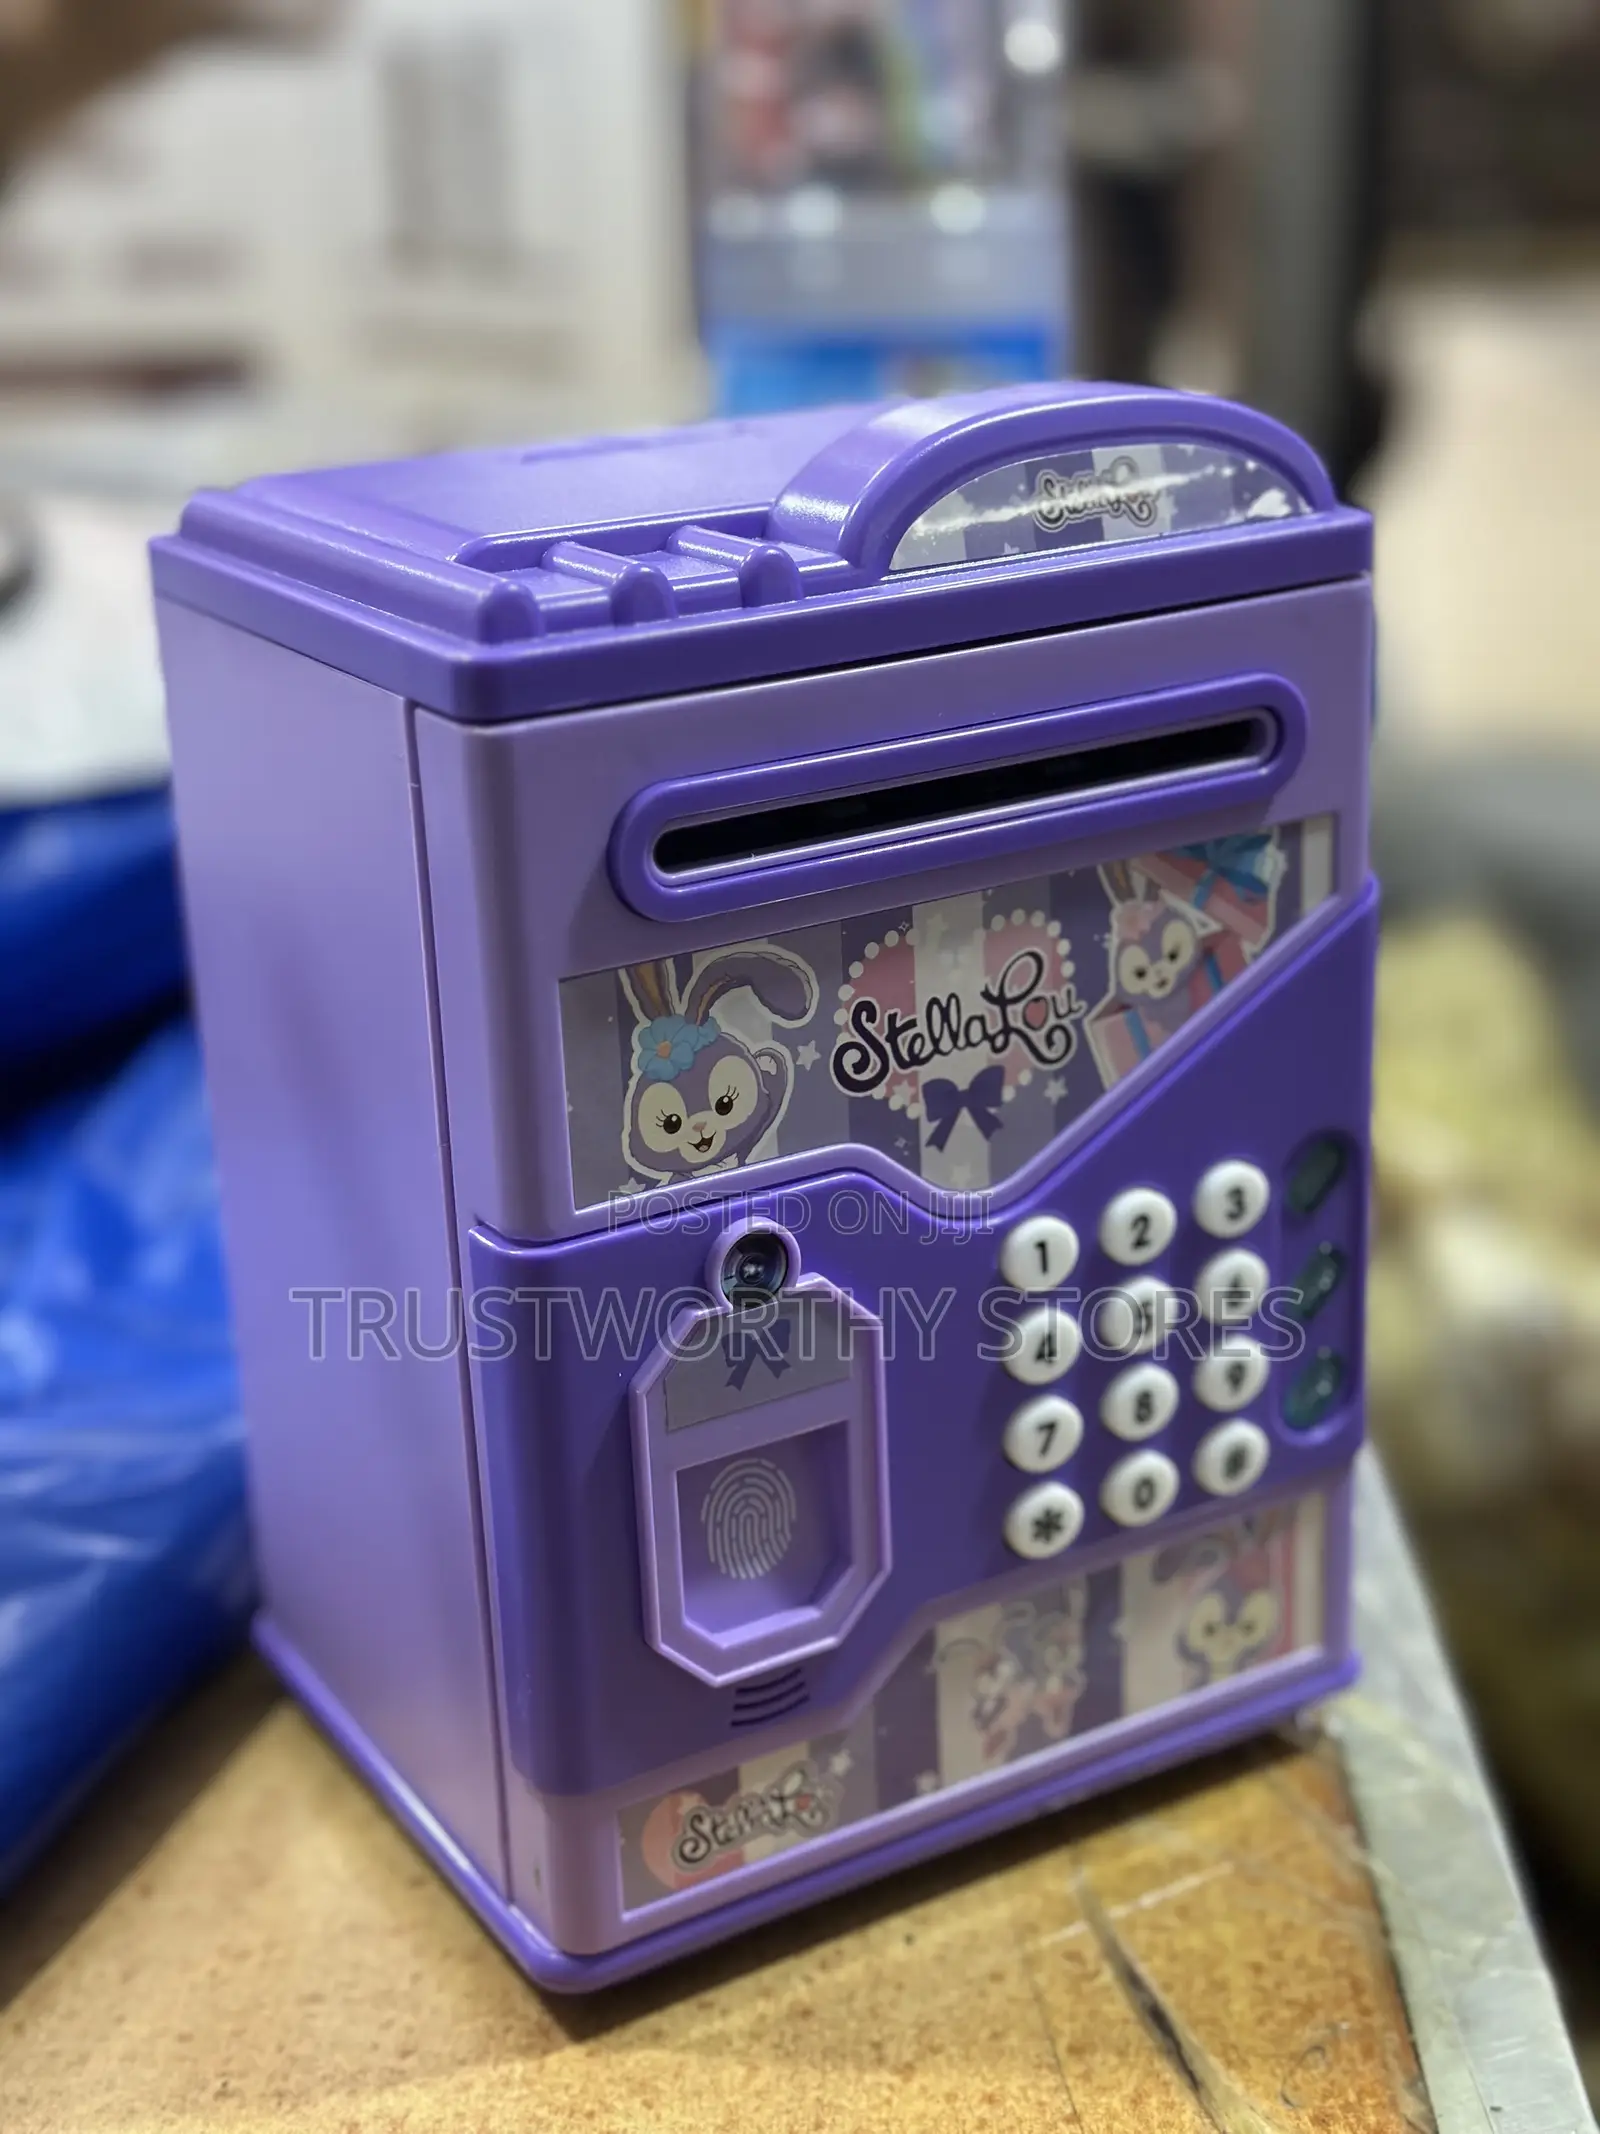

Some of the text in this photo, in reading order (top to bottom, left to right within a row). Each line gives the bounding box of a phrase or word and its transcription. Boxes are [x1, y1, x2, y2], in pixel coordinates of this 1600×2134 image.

[1034, 1187, 1246, 1275] 1 2 3
[1034, 1330, 1056, 1366] 4
[1035, 1420, 1058, 1457] 7
[1132, 1475, 1157, 1511] 0
